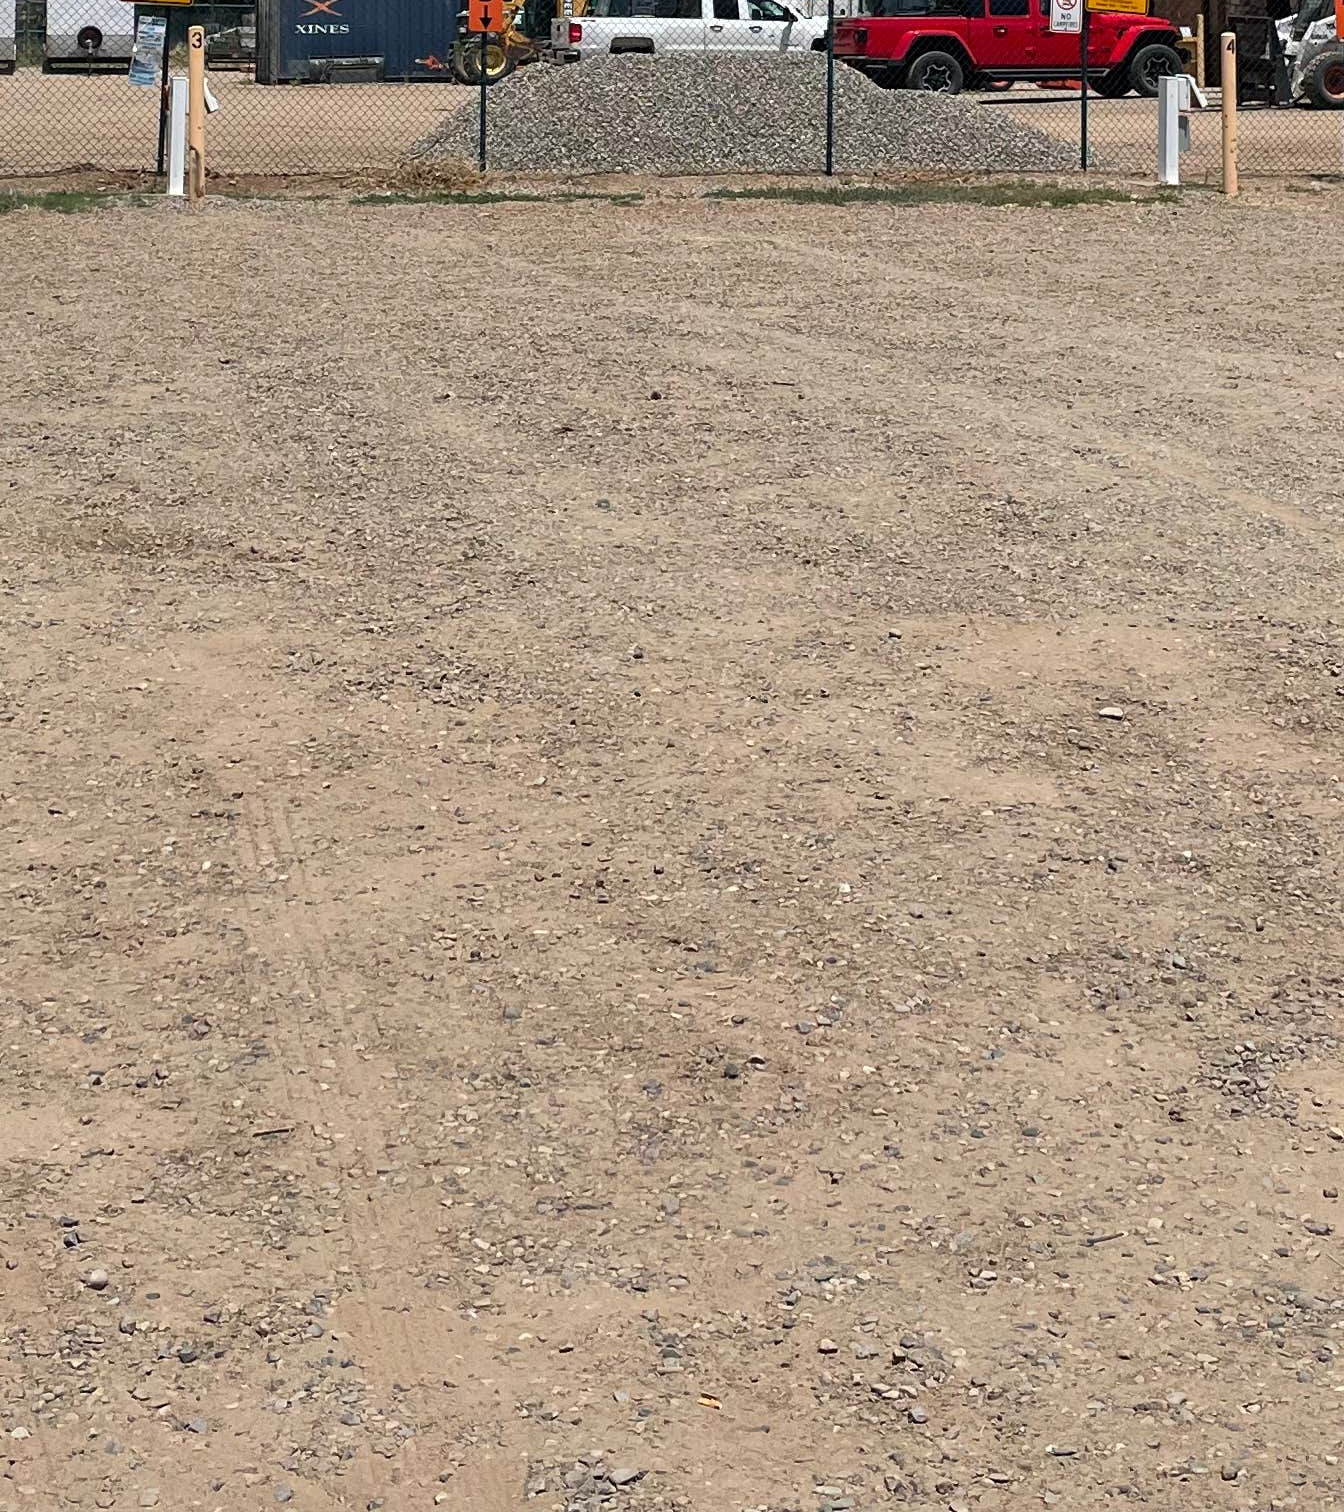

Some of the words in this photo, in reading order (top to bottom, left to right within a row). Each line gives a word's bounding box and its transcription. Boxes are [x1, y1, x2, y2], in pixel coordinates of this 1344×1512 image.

[294, 24, 350, 34] XINES
[192, 31, 202, 48] 3
[1226, 39, 1235, 54] 4
